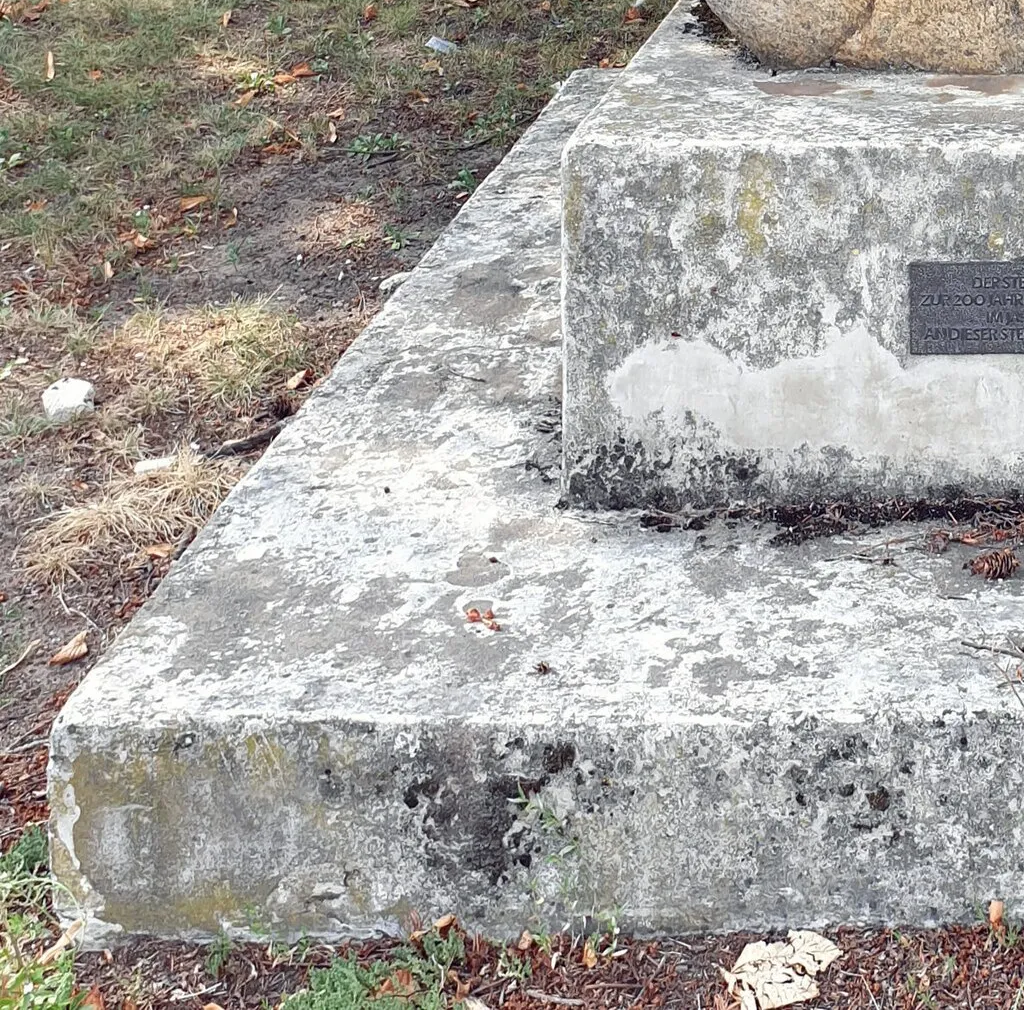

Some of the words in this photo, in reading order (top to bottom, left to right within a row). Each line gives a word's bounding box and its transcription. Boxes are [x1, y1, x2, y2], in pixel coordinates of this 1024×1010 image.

[973, 276, 1001, 289] DER
[920, 293, 951, 307] ZUR
[986, 311, 1005, 323] IM
[924, 327, 947, 341] AN
[948, 327, 998, 341] DIESER
